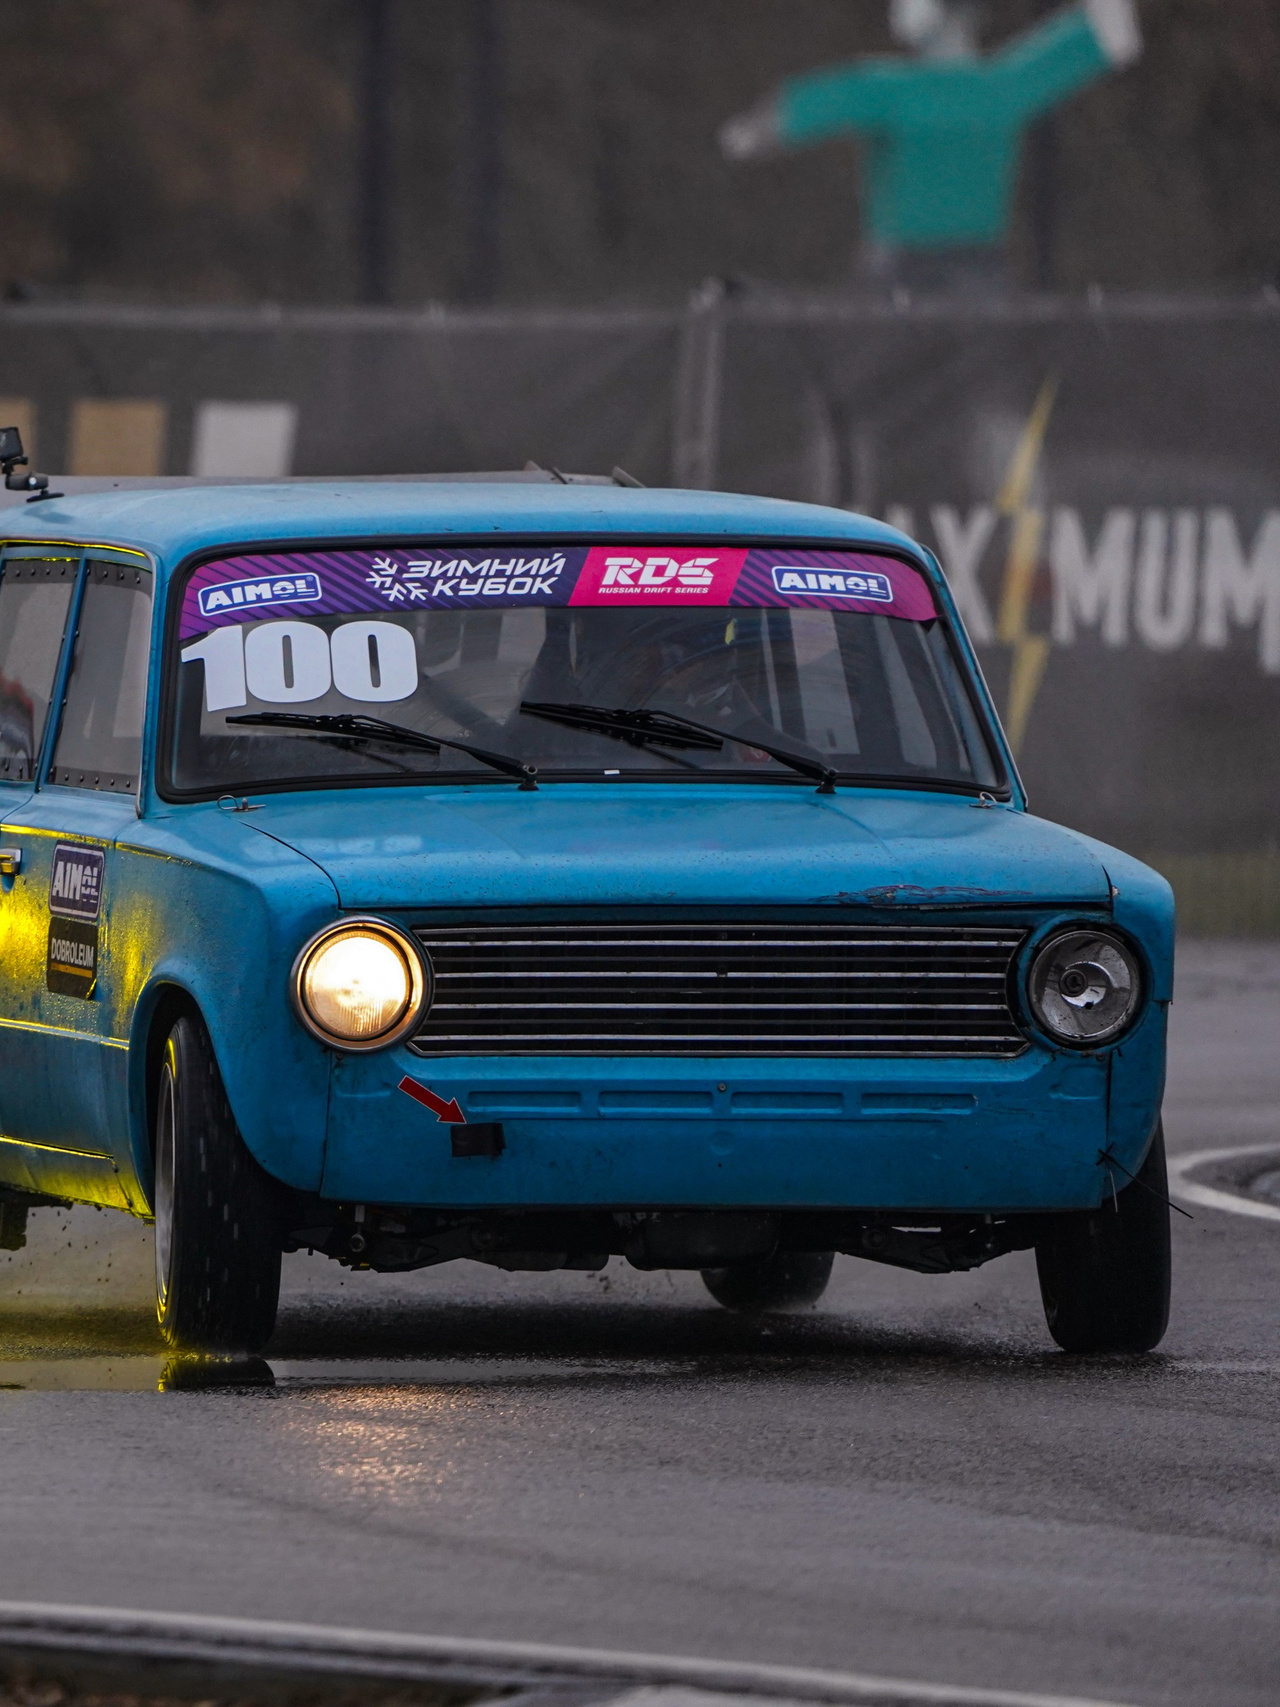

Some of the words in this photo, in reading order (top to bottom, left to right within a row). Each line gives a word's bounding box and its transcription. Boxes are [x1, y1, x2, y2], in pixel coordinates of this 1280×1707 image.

[402, 553, 566, 579] ЗИМНИЙ
[601, 557, 720, 585] RDS
[205, 578, 317, 611] AIMOL
[432, 576, 559, 597] КУБОК
[598, 586, 641, 594] RUSSIAN
[643, 586, 673, 594] DRIFT
[674, 586, 709, 594] SERIES
[780, 571, 888, 597] AIMOL
[180, 620, 419, 712] 100
[51, 860, 99, 904] AIMOL
[50, 937, 95, 968] DOBROLEUM
